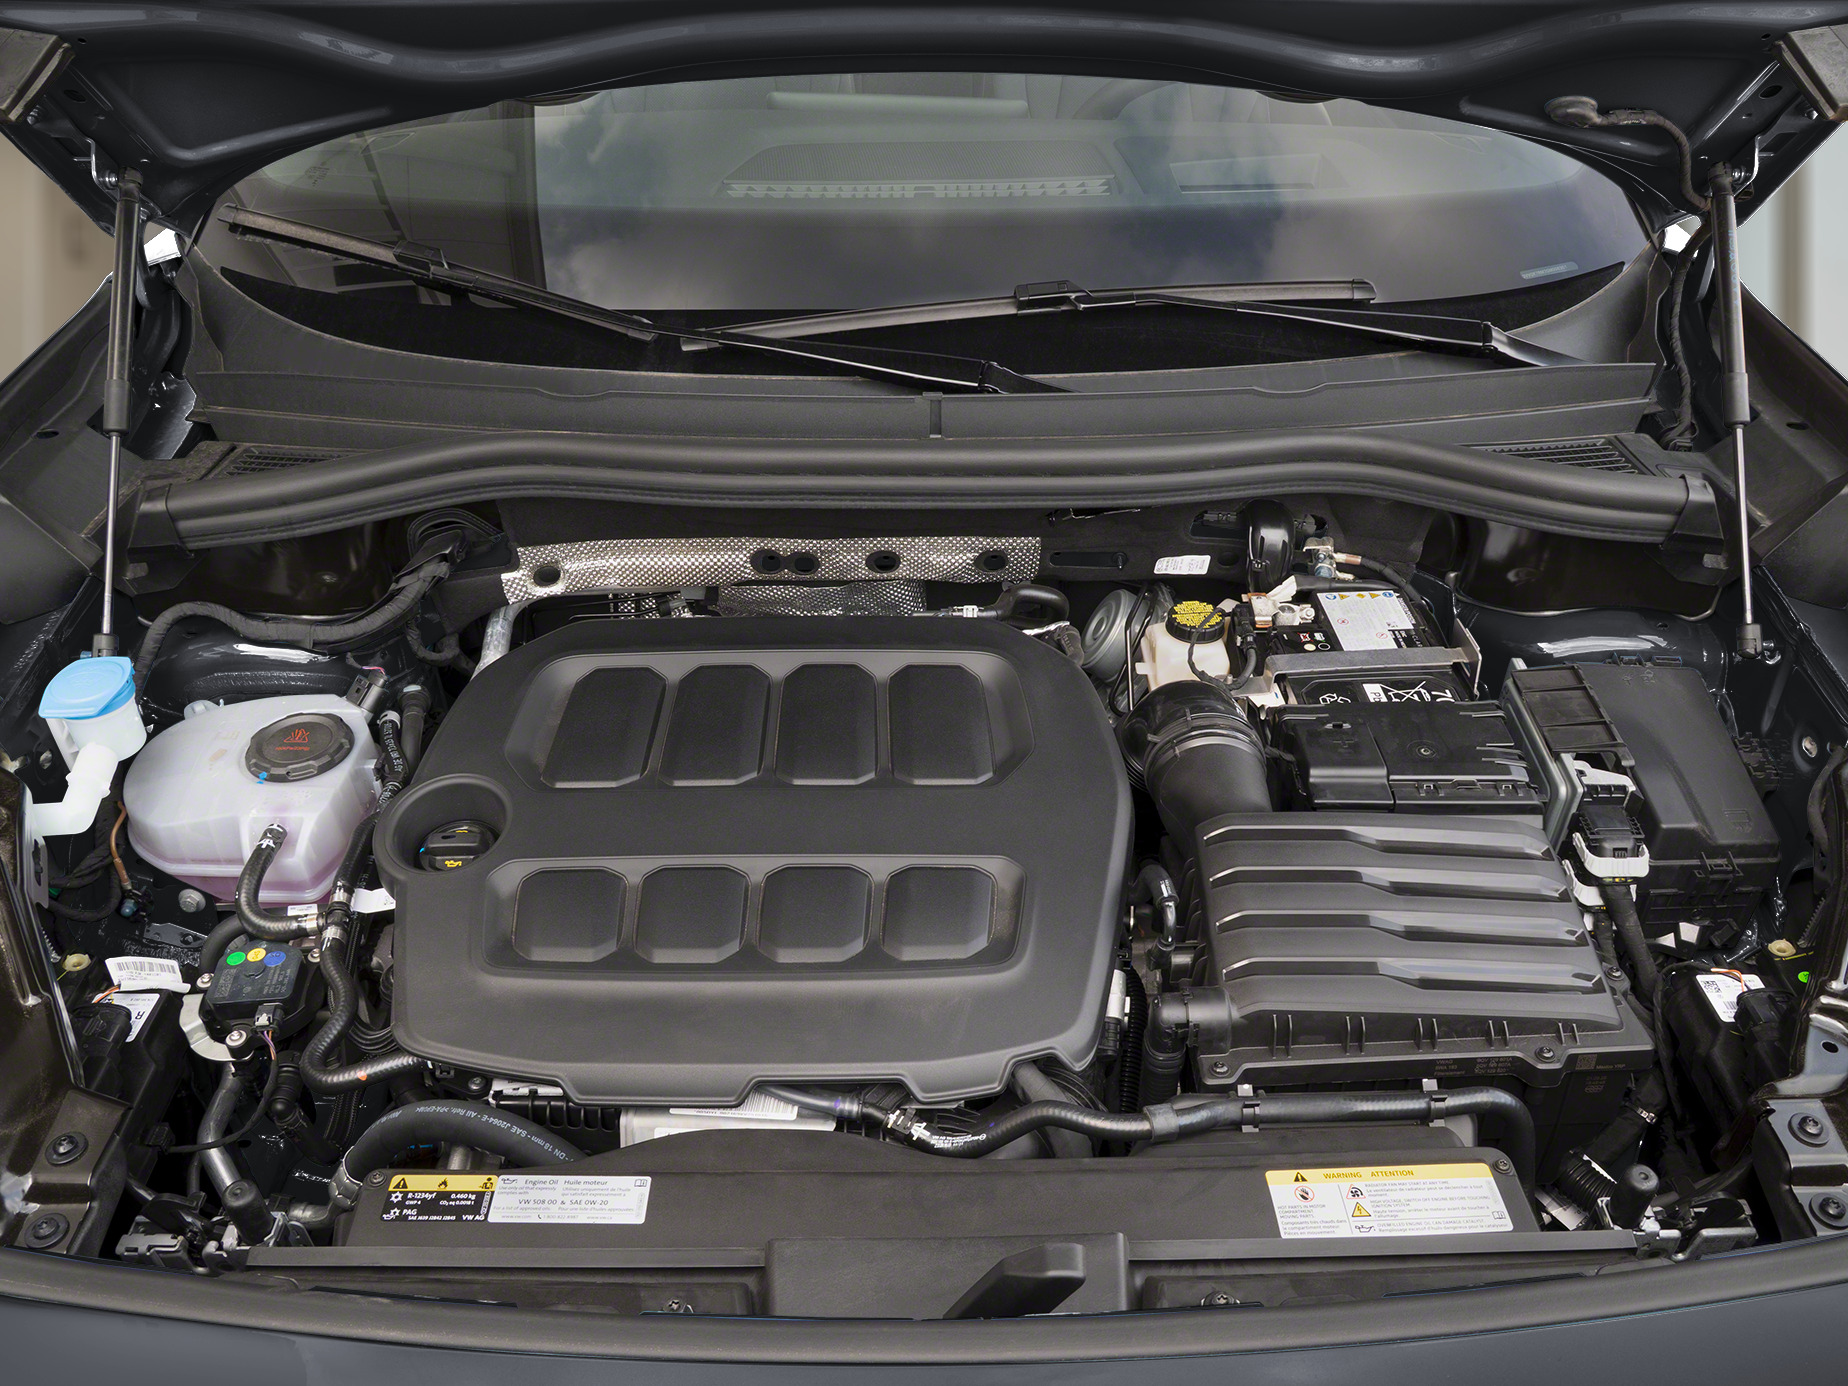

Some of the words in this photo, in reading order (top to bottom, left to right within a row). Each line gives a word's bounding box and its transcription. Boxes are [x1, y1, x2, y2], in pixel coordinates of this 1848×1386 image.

[135, 1011, 145, 1019] R
[510, 1125, 528, 1138] SAE
[531, 1136, 545, 1146] mm
[544, 1144, 553, 1152] 18
[553, 1149, 566, 1160] DN
[1323, 1171, 1363, 1179] WARNING
